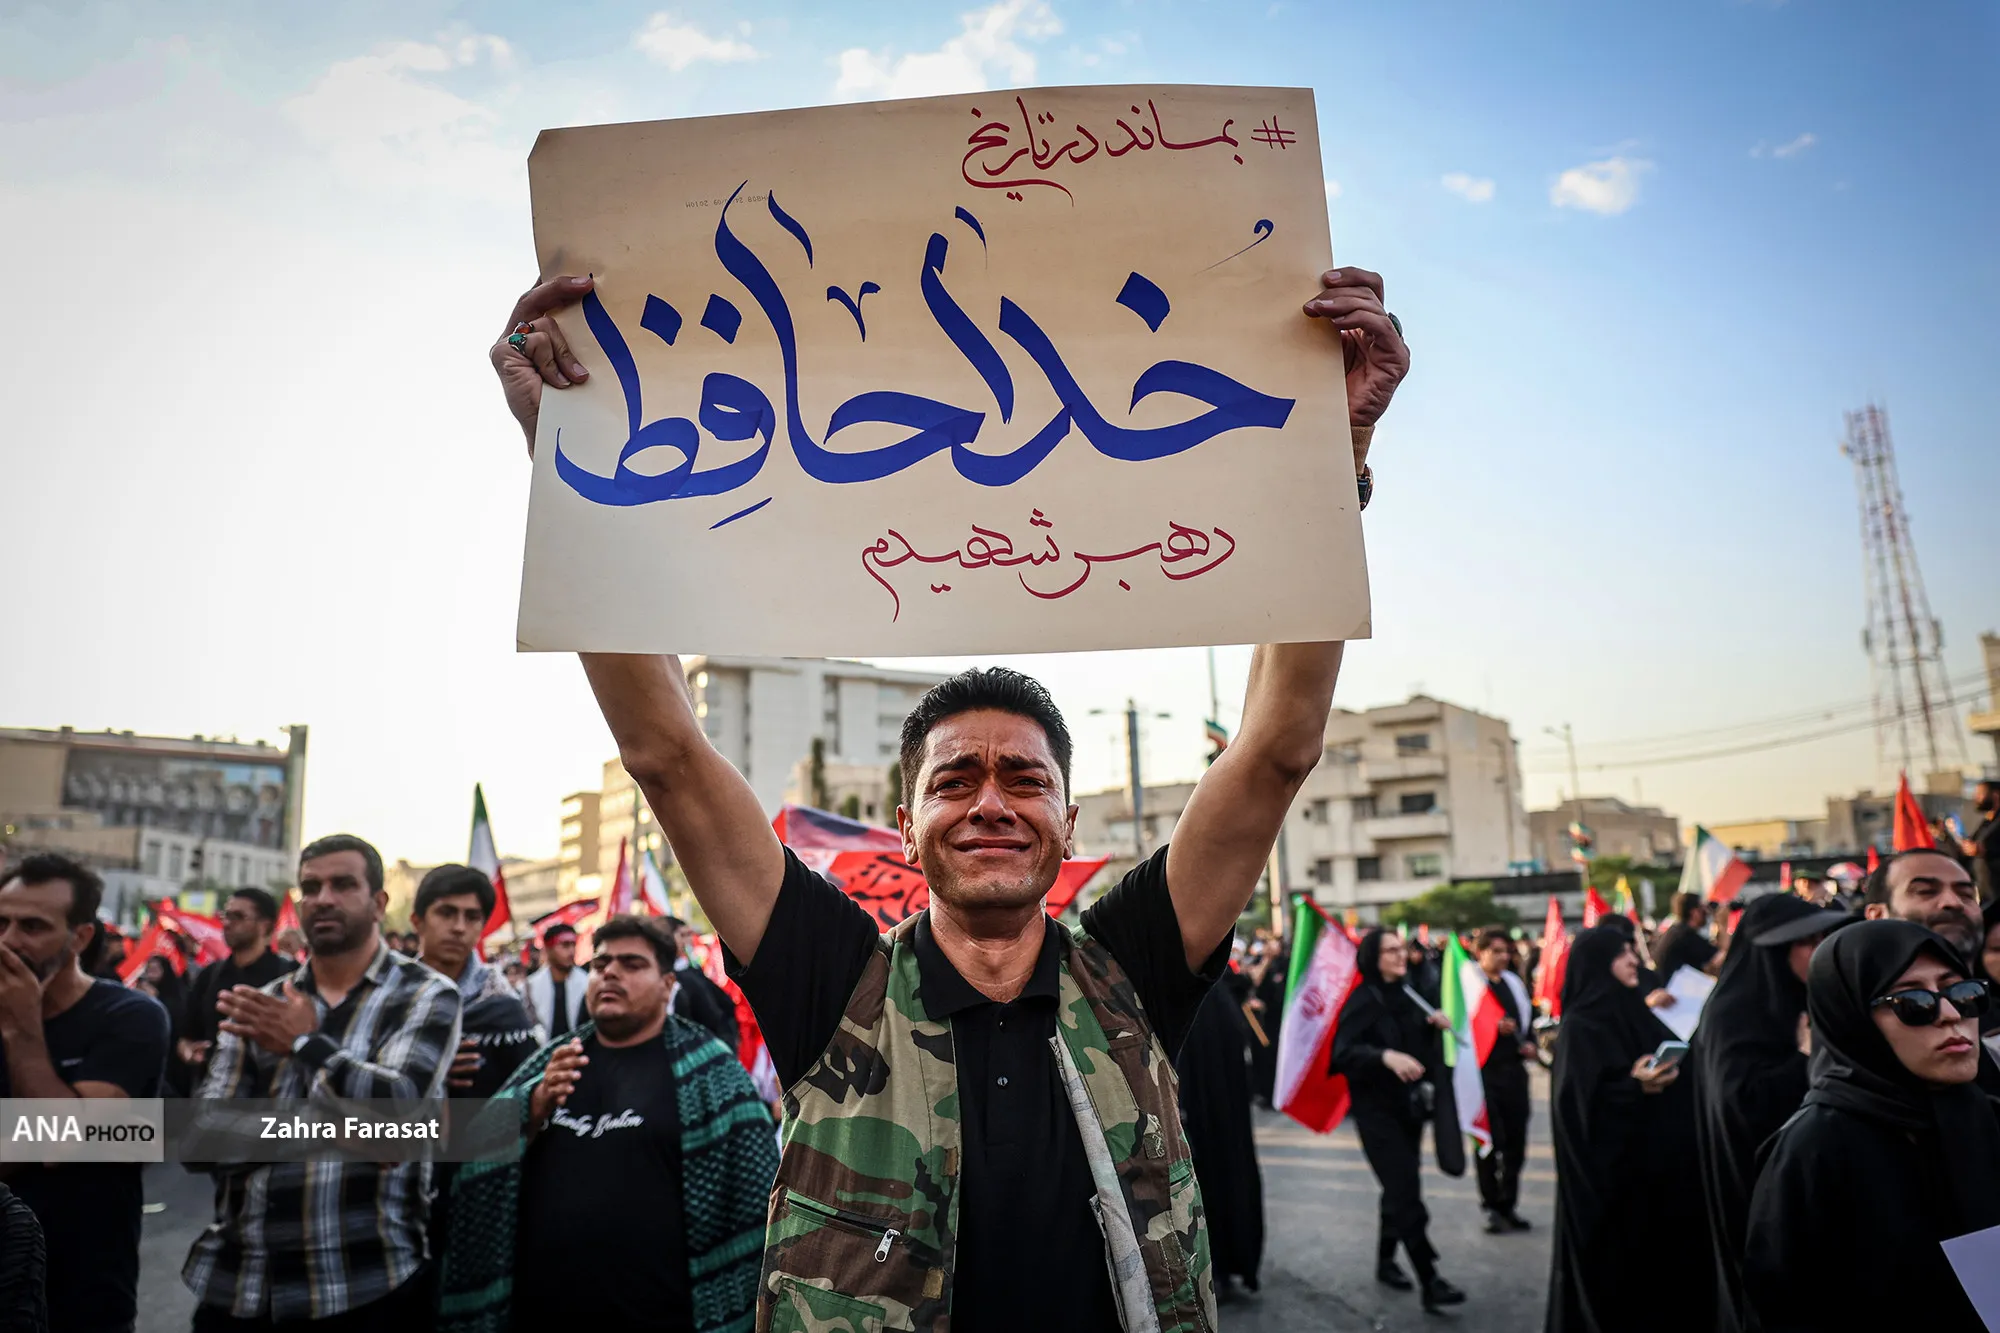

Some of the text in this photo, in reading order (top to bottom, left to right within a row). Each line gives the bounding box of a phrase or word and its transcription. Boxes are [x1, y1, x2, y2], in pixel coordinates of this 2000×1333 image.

[1031, 124, 1099, 170] در
[862, 508, 1236, 624] رهبر شهیدم
